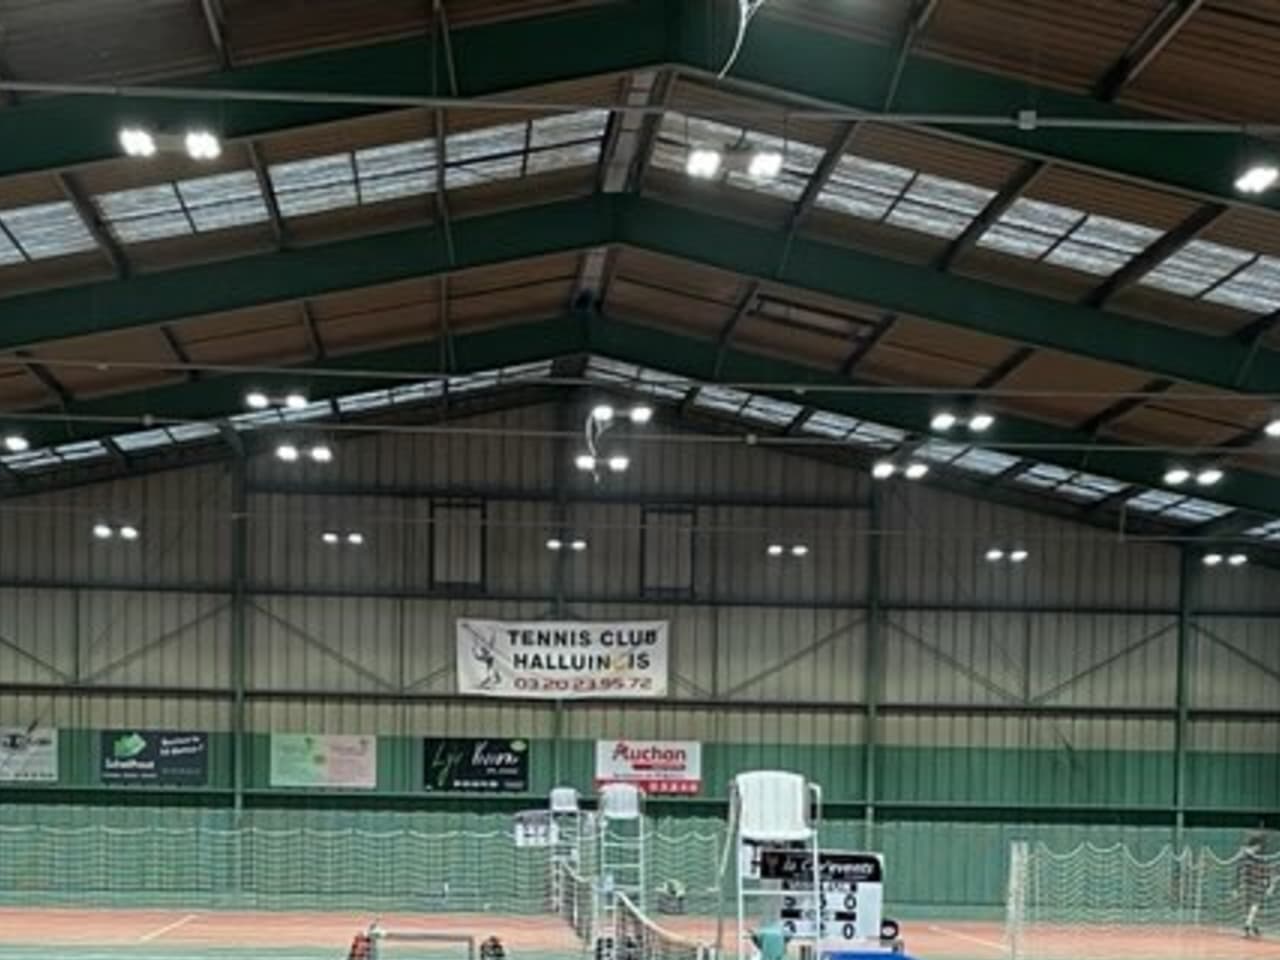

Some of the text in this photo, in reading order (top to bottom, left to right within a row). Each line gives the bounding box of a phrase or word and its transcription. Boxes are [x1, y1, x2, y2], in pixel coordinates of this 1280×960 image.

[507, 629, 658, 647] TENNIS CLUB
[611, 742, 686, 761] Auchan
